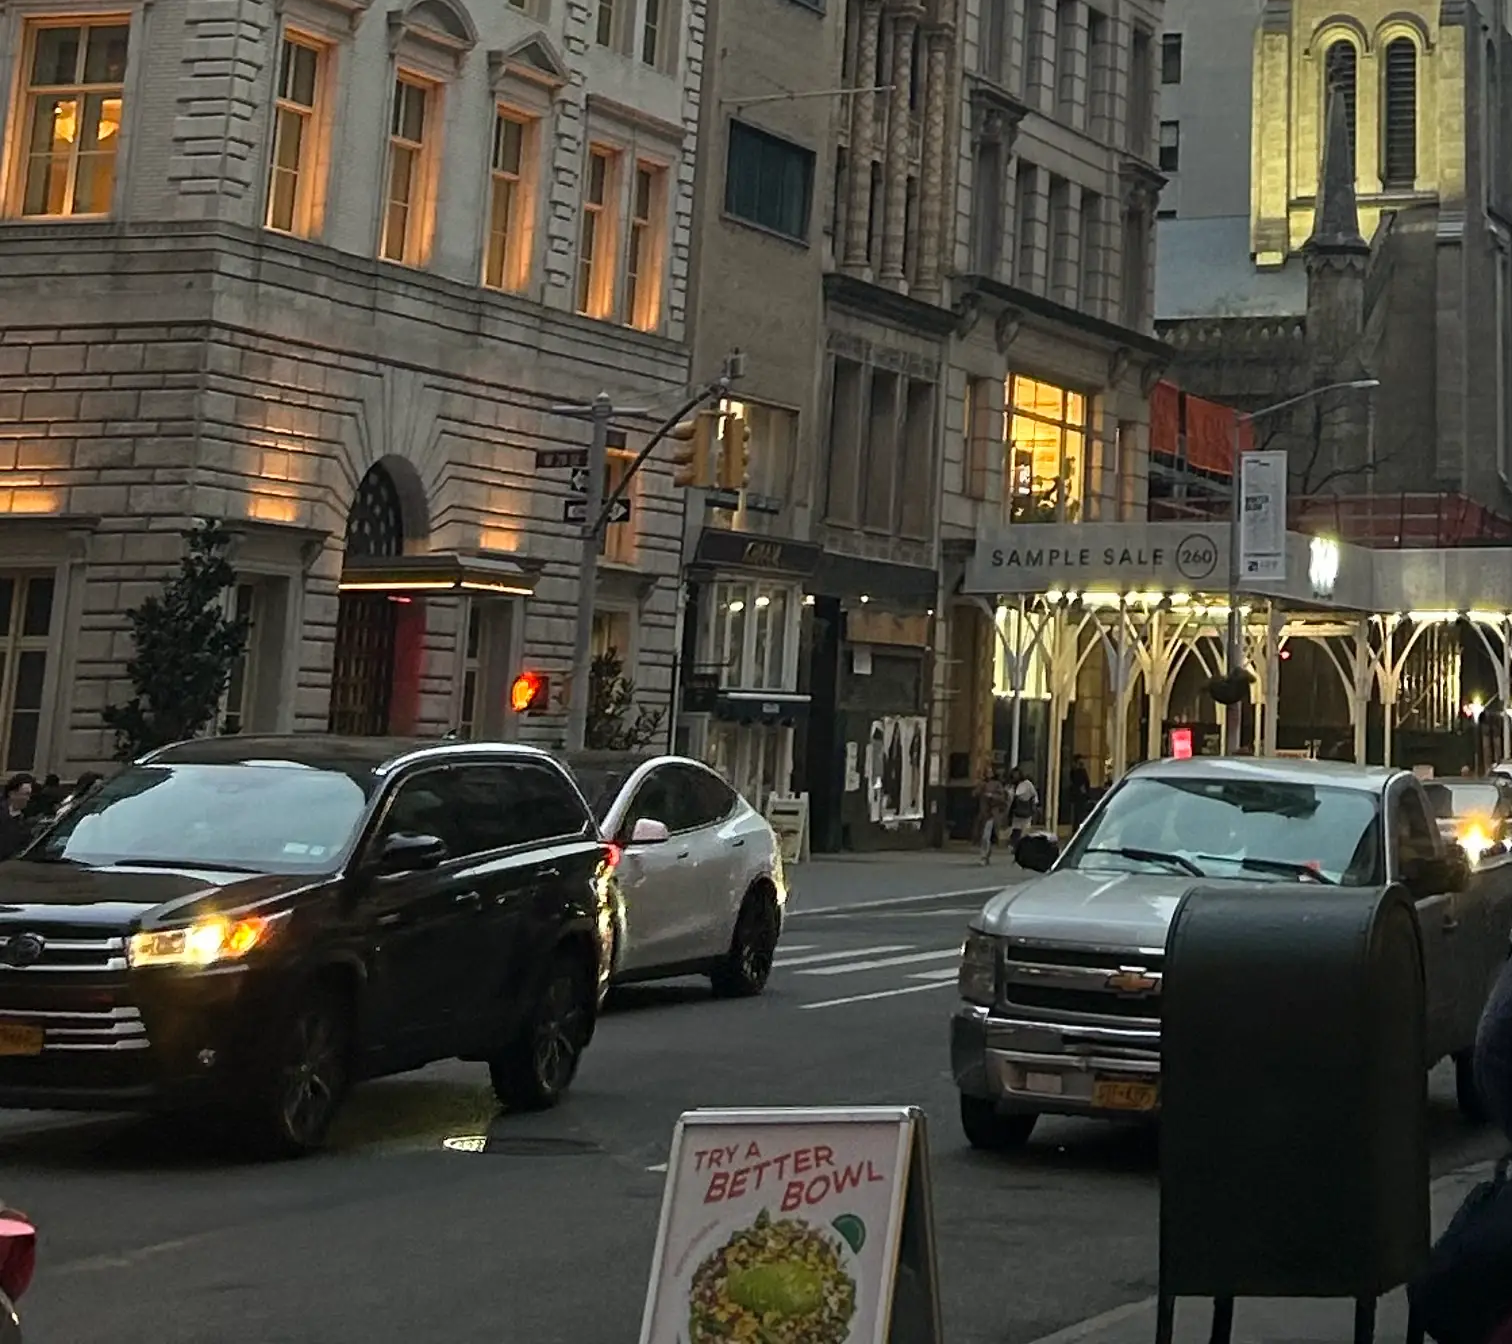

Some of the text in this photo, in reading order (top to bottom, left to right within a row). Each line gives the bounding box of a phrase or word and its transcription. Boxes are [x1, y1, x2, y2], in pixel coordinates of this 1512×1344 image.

[991, 547, 1212, 567] SAMPLE SALE 260
[694, 1141, 762, 1172] TRY A
[703, 1145, 835, 1204] BETTER
[780, 1160, 884, 1212] BOWL
